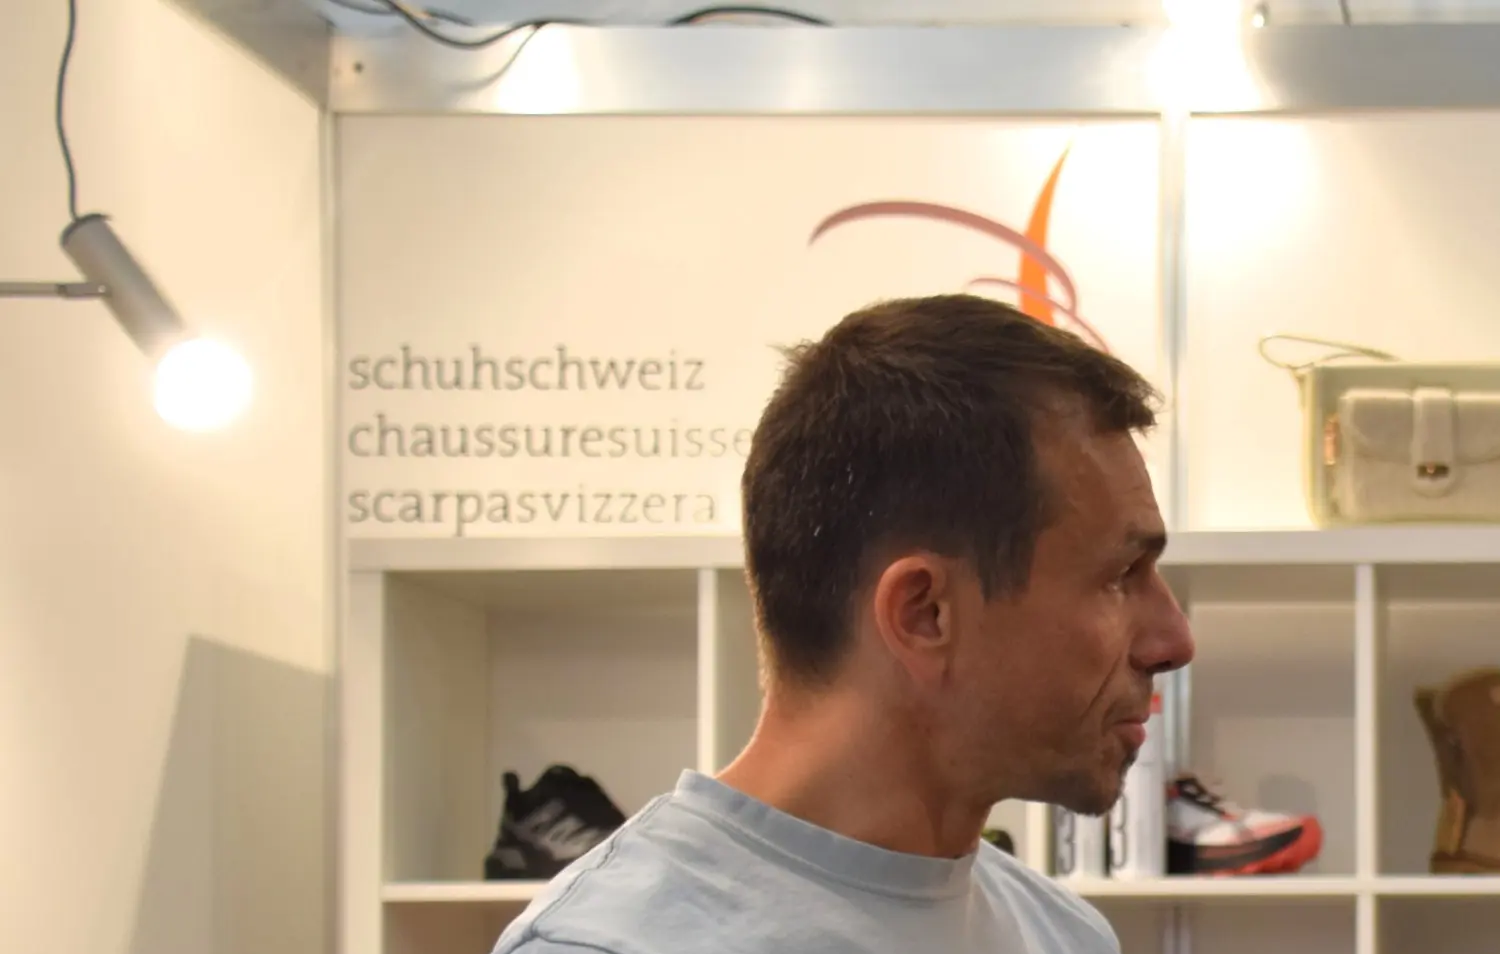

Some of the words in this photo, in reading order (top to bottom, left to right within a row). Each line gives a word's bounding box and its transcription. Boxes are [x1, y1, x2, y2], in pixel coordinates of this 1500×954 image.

[348, 344, 706, 391] schuhschweiz
[348, 413, 753, 458] chaussuresuisse
[348, 483, 717, 537] scarpasvizzera
